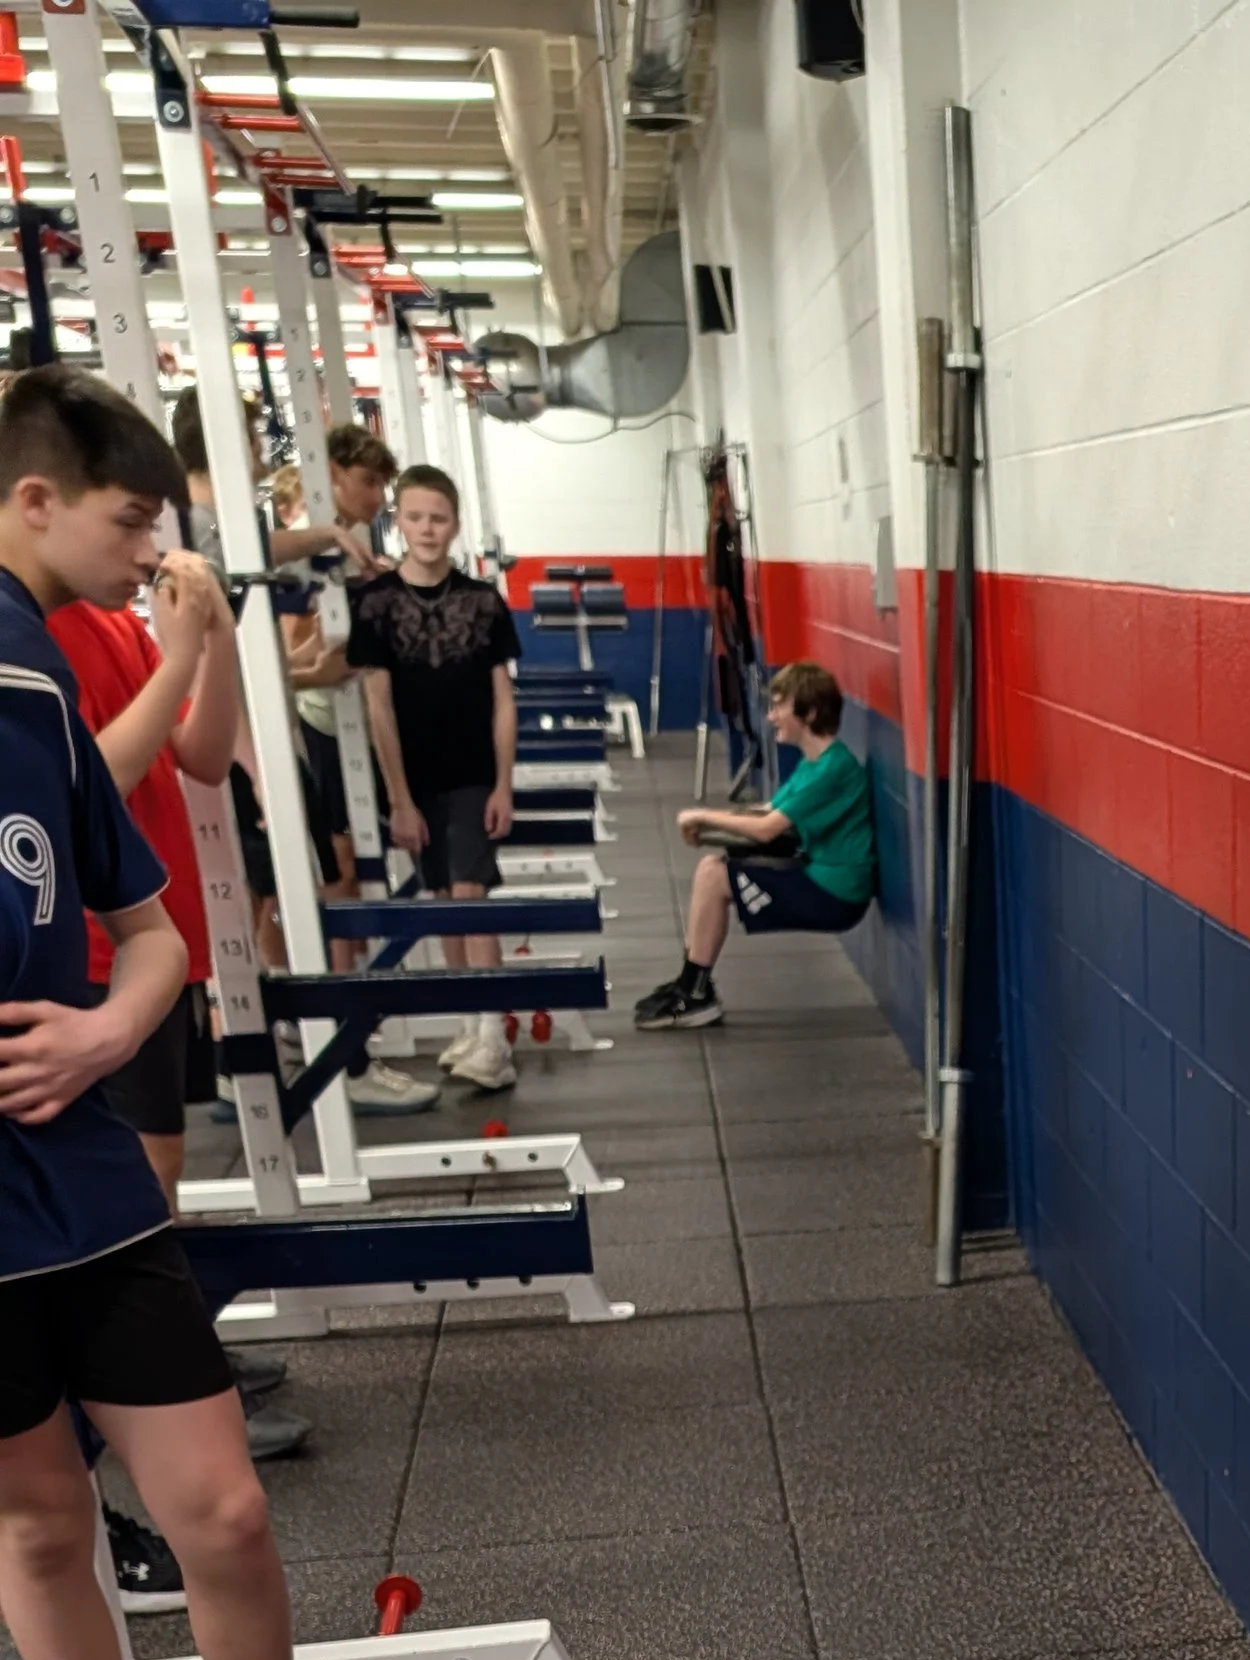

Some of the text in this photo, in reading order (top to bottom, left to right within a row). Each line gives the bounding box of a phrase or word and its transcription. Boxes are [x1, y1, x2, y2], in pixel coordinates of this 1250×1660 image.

[89, 171, 100, 193] 1
[100, 243, 116, 264] 2
[112, 312, 128, 334] 3
[199, 822, 221, 841] 11
[0, 813, 56, 926] 9
[209, 881, 233, 900] 12
[220, 937, 244, 958] 13
[259, 1154, 279, 1173] 17
